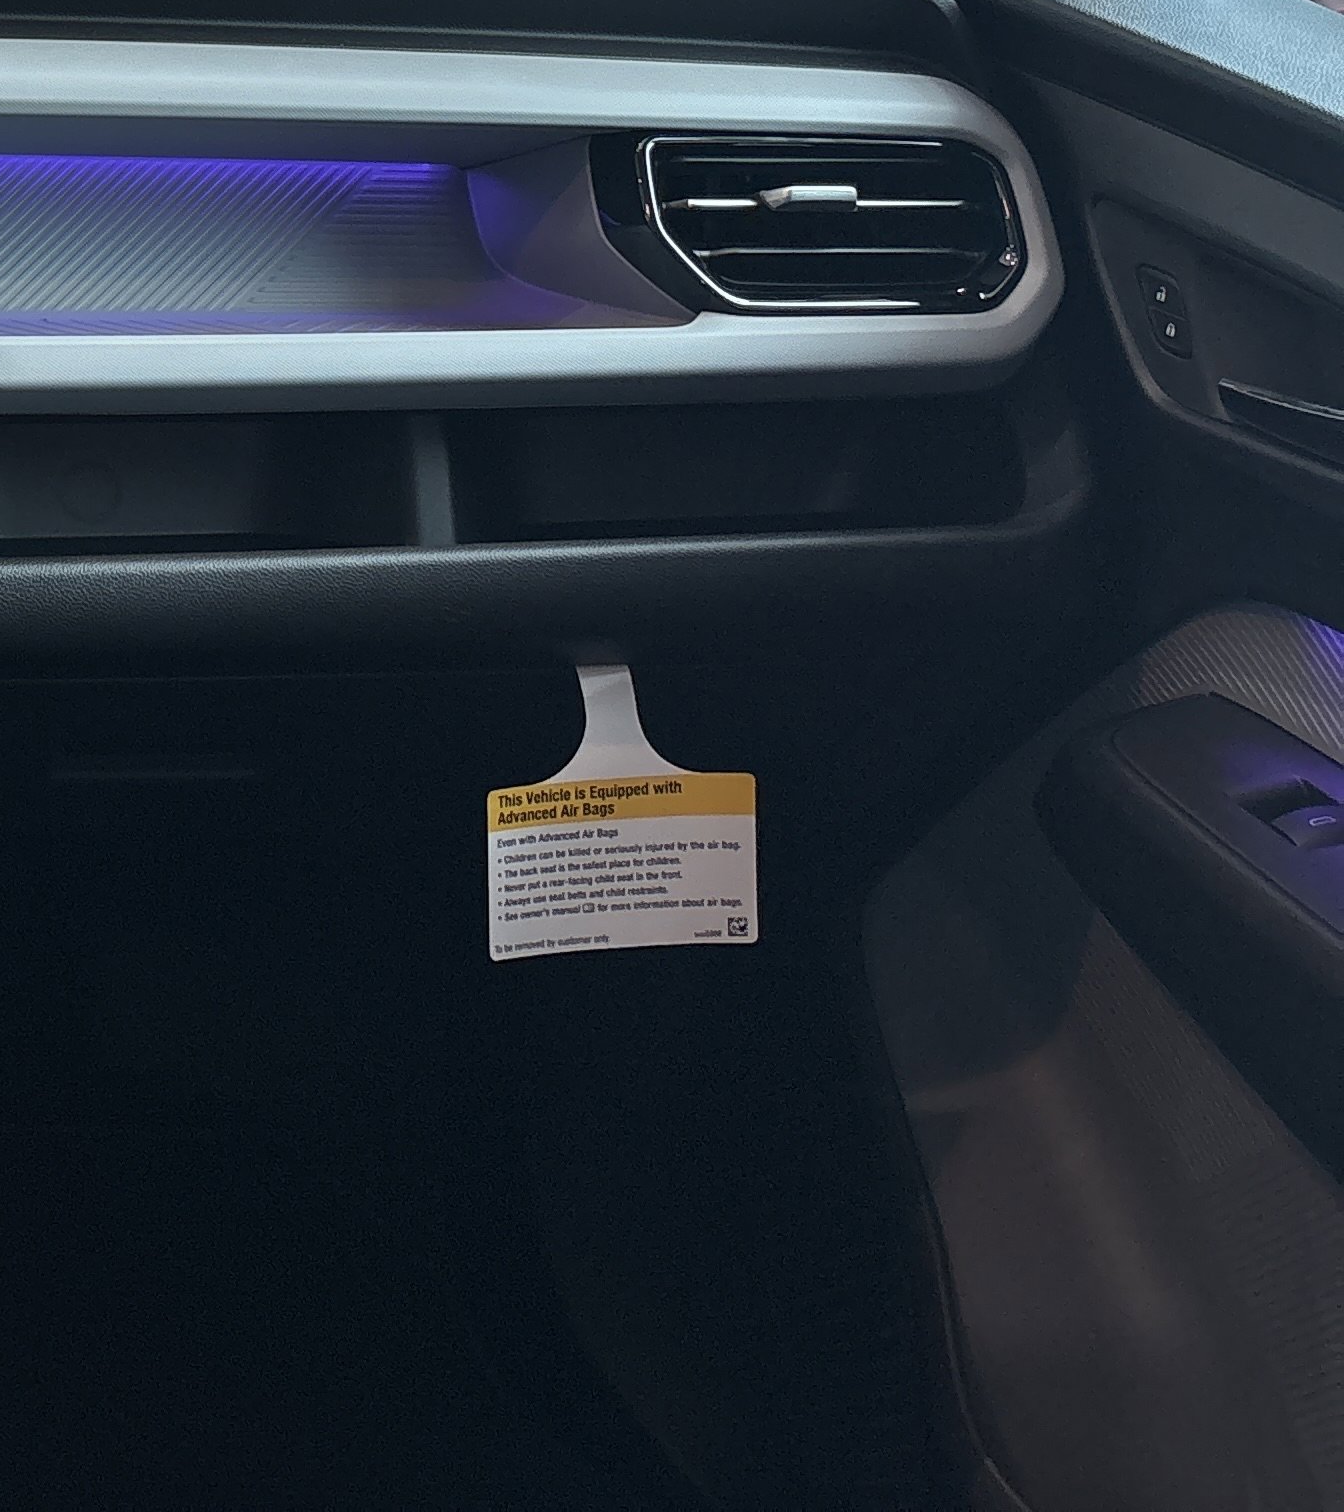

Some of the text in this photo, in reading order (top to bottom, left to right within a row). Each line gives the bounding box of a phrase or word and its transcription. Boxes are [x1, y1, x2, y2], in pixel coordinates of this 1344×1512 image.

[498, 795, 523, 809] This
[526, 788, 571, 805] Vehicle
[590, 783, 649, 800] Equipped
[653, 781, 683, 794] with
[498, 803, 615, 825] Advanced Air Bags
[497, 828, 618, 848] Even with Advanced Air Bags
[504, 853, 537, 864] Children
[539, 851, 553, 860] can
[556, 850, 566, 858] be
[568, 847, 591, 856] killed
[677, 841, 688, 852] by
[690, 841, 705, 849] the
[707, 841, 719, 849] air
[505, 870, 518, 878] The
[520, 866, 538, 876] back
[558, 864, 565, 872] is
[568, 863, 580, 871] the
[633, 858, 644, 866] for
[528, 881, 540, 891] put
[595, 874, 615, 884] child
[636, 872, 644, 880] in
[646, 871, 659, 880] the
[589, 889, 603, 898] and
[606, 888, 625, 897] child
[504, 912, 518, 921] See
[597, 904, 608, 912] for
[682, 899, 705, 907] about
[707, 898, 718, 907] air
